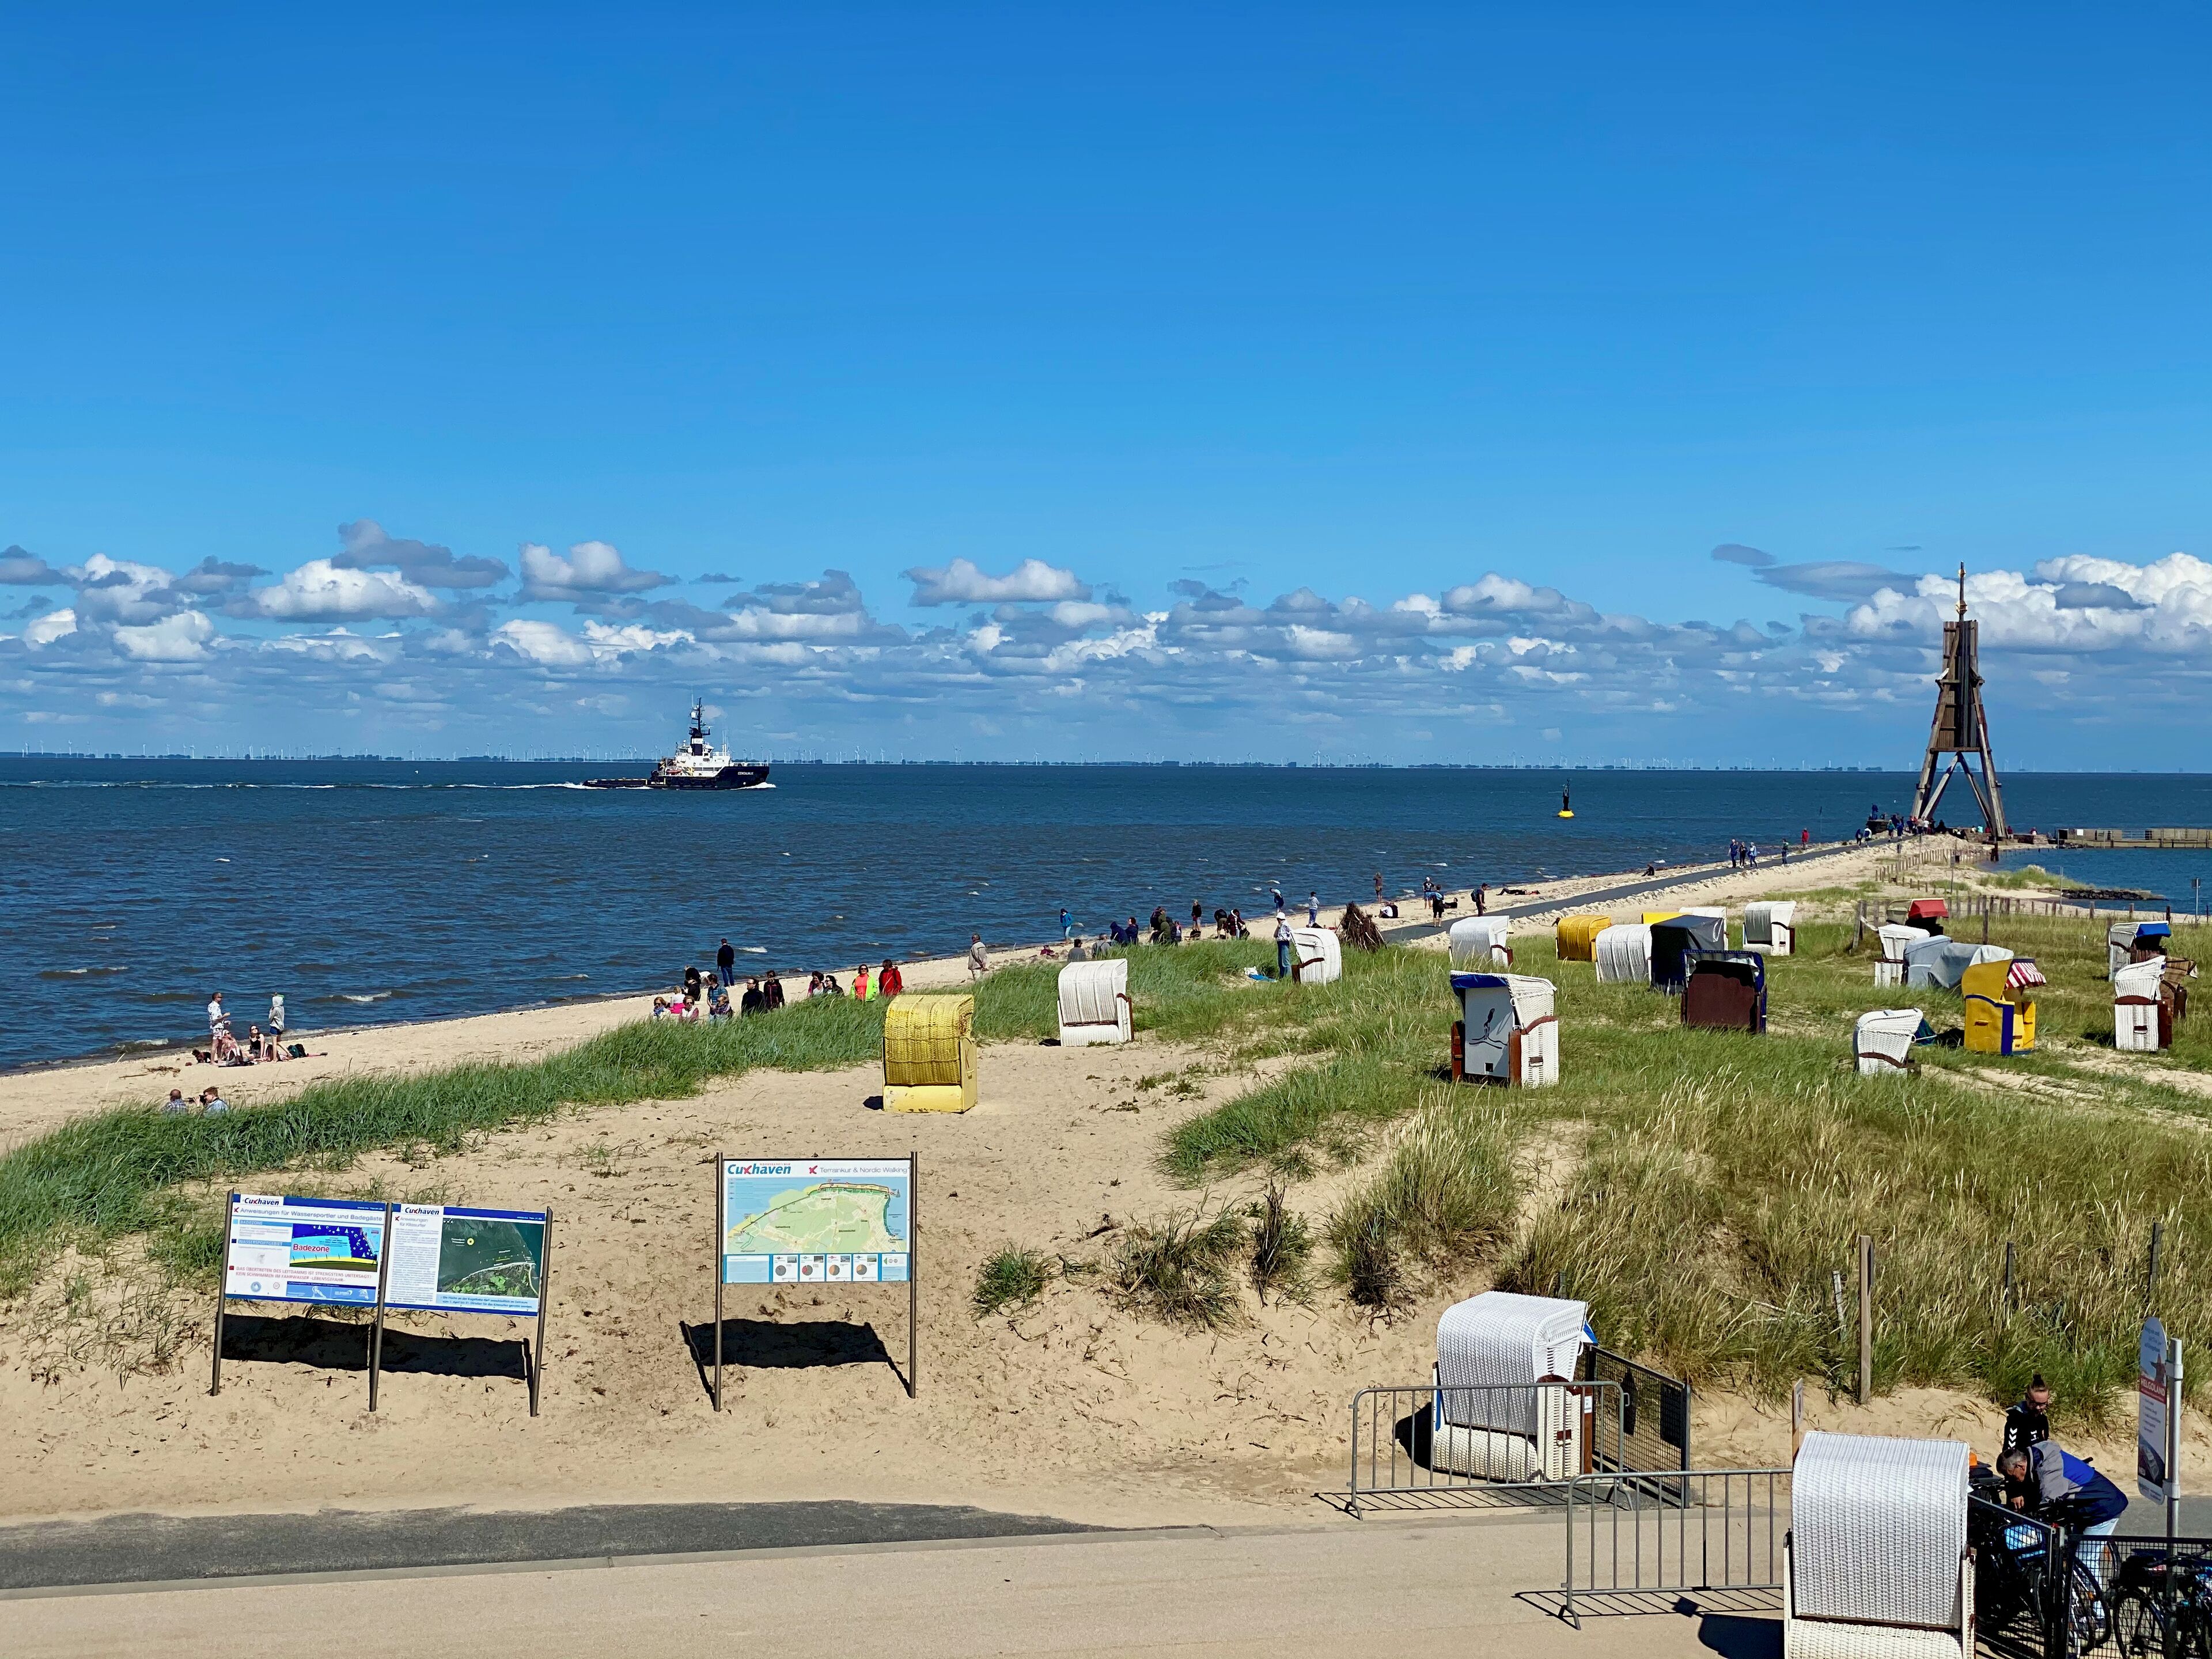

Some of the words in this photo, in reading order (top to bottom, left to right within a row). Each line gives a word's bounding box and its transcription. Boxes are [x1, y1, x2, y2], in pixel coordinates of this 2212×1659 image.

[728, 1163, 791, 1175] Cuxhaven
[244, 1198, 279, 1206] Cuxhaven
[240, 1207, 280, 1215] Anweisungen
[291, 1210, 336, 1219] Wassersportler
[405, 1207, 440, 1215] Cuxhaven
[293, 1243, 330, 1252] Badezone
[2140, 1377, 2166, 1397] HELGOLAND
